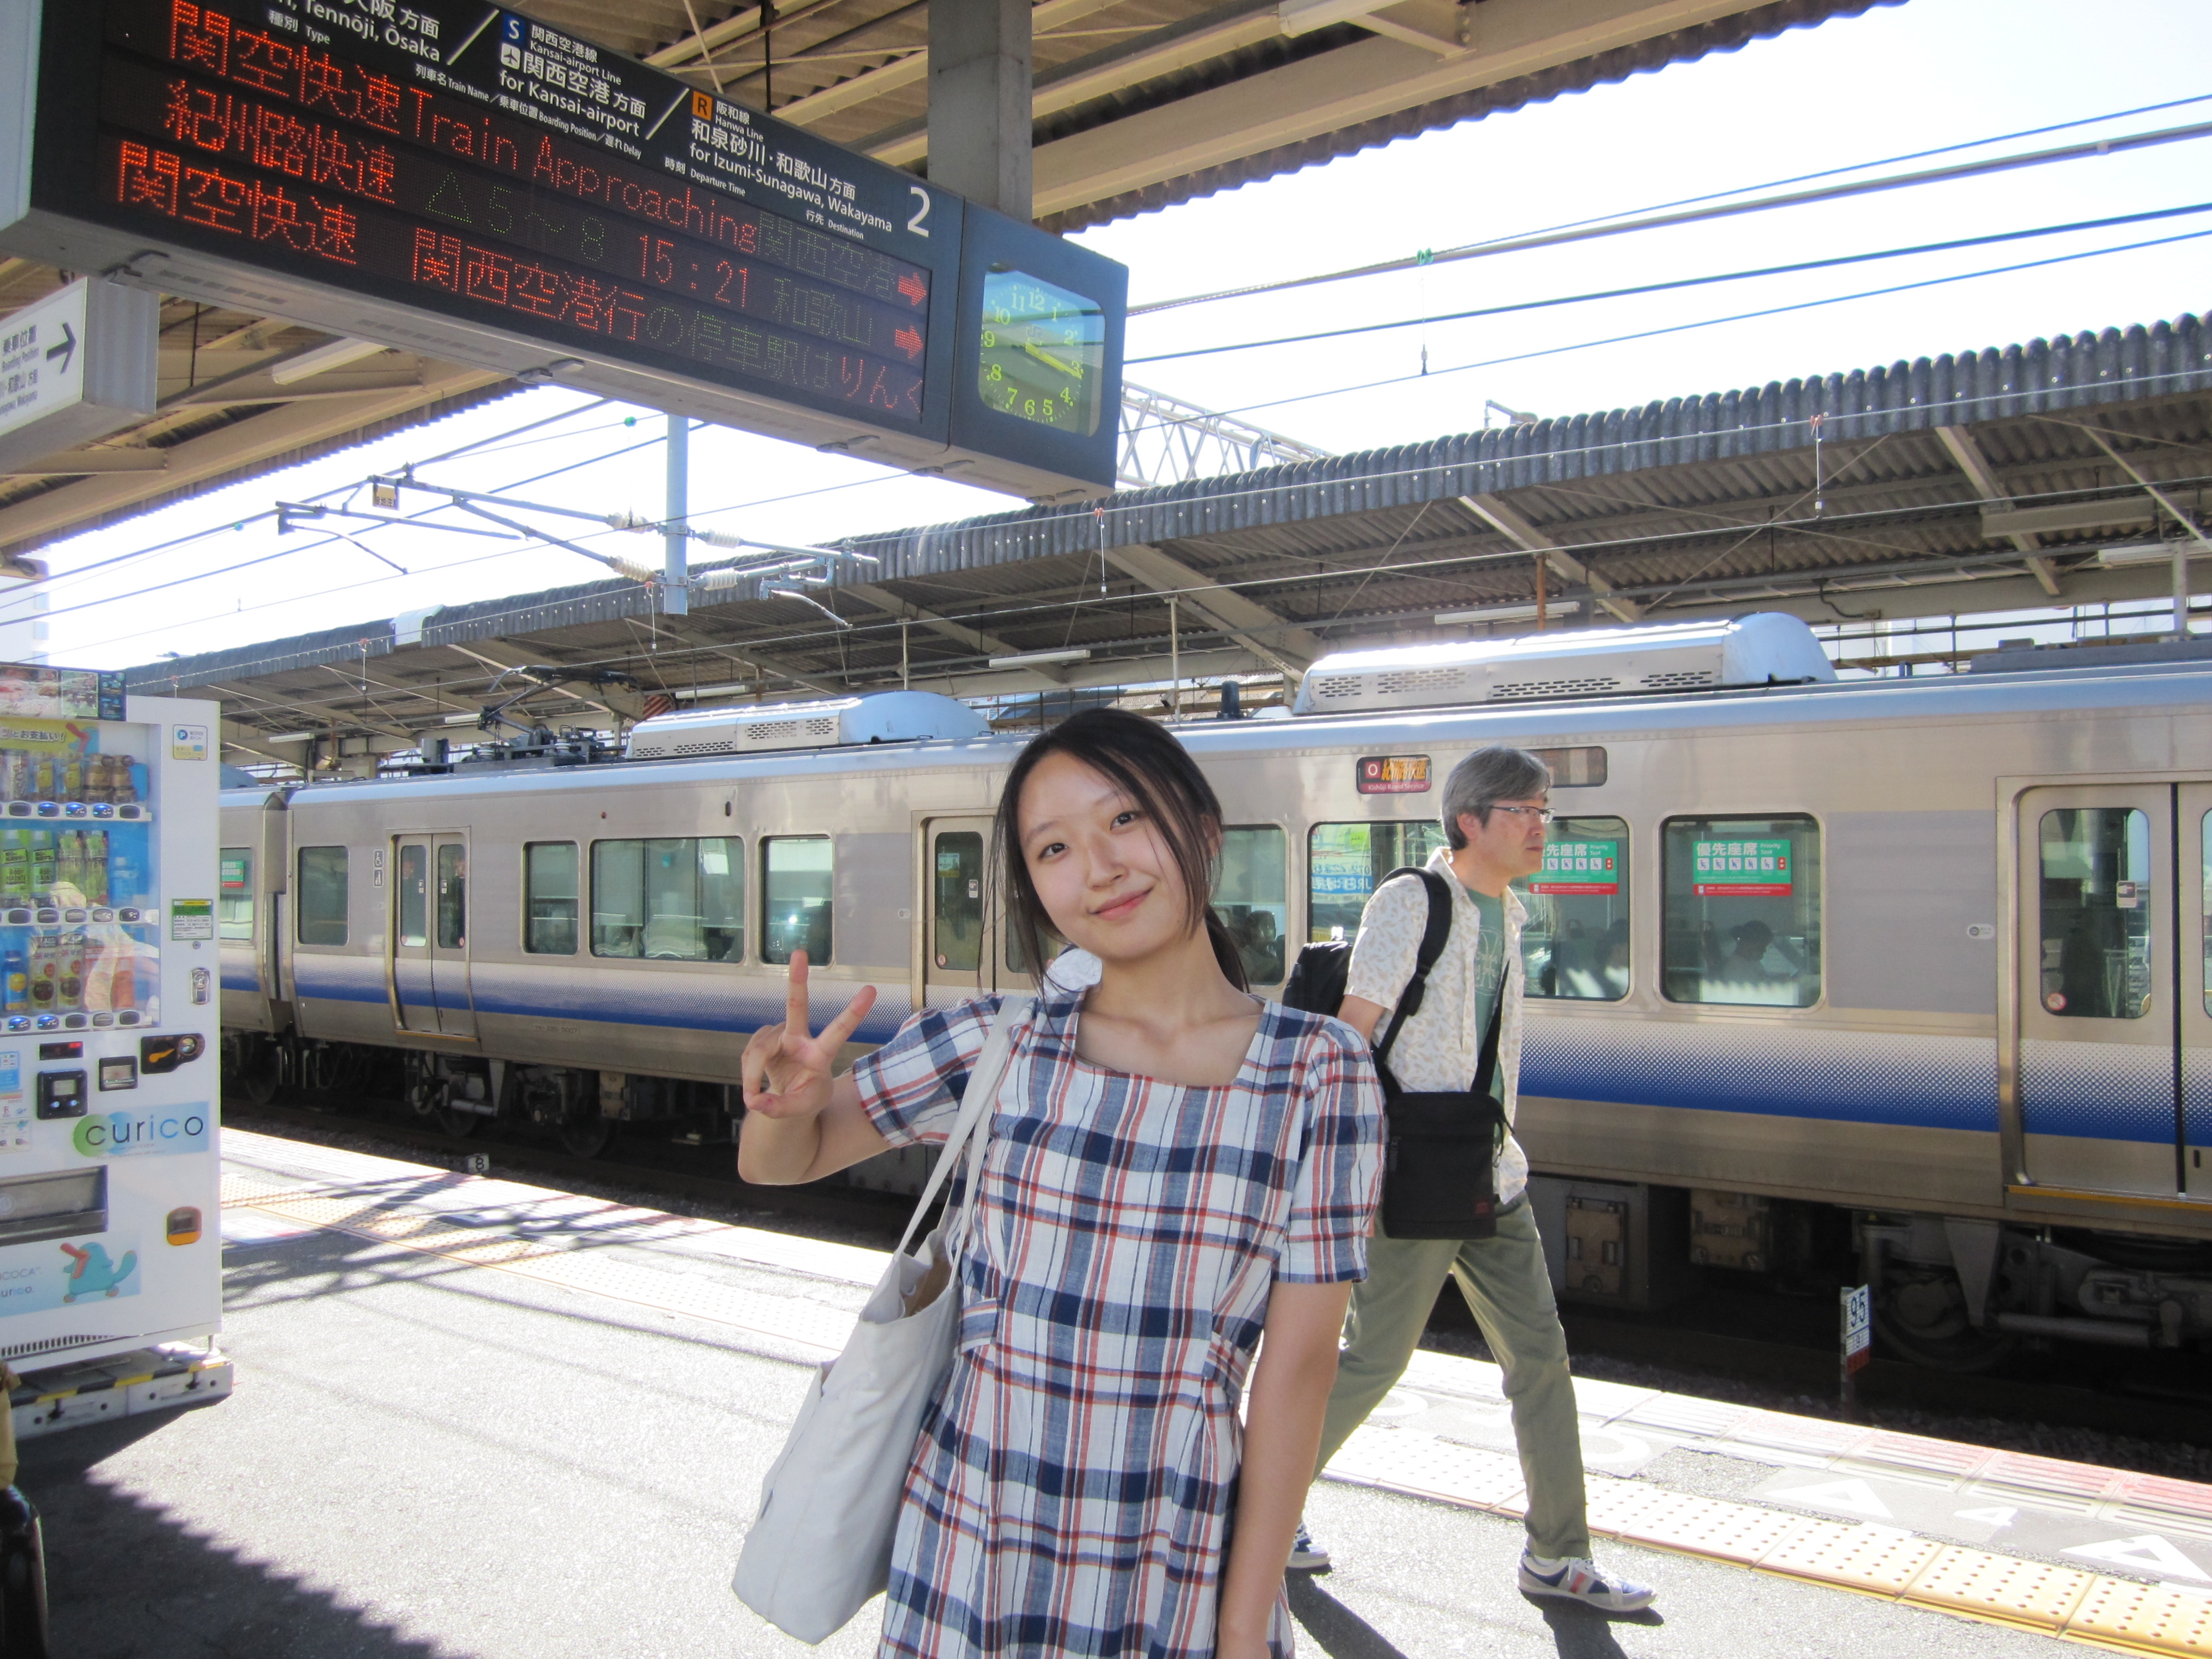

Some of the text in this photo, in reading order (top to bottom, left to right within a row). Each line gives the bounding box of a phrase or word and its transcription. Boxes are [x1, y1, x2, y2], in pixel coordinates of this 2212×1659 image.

[269, 9, 298, 32] 種別
[509, 20, 520, 39] S
[305, 25, 331, 44] Type
[385, 23, 440, 62] Ōsaka
[531, 25, 598, 63] 関西空港線
[170, 0, 400, 135] 関空快速
[530, 40, 622, 86] Kansai-airport Line
[415, 64, 447, 87] 列車名
[448, 77, 490, 102] Train Name
[499, 95, 538, 120] 乗車位置
[500, 71, 640, 137] for Kansai-airport
[697, 97, 708, 116] R
[716, 101, 749, 125] 阪和線
[539, 112, 597, 142] Boarding Position
[715, 116, 764, 143] Hanwa Line
[165, 79, 395, 204] 紀州路快速
[624, 143, 641, 160] Delay
[409, 87, 757, 255] Train Approaching
[665, 156, 686, 175] 時刻
[690, 168, 746, 197] Departure Time
[690, 142, 893, 233] for Izumi-Sunagawa, Wakayama
[117, 140, 356, 265] 関空快速
[907, 186, 931, 238] 2
[806, 210, 825, 226] 行先
[828, 219, 864, 240] Destination
[758, 211, 895, 300] 関西空港
[773, 278, 872, 346] 和歌山
[1029, 291, 1045, 311] 12
[994, 306, 1011, 325] 10
[983, 330, 995, 348] 9
[1065, 329, 1074, 346] 2
[990, 364, 1002, 381] 8
[1007, 387, 1018, 405] 7
[1060, 387, 1071, 403] 4
[1024, 399, 1035, 416] 6
[1042, 399, 1053, 416] 5
[1543, 843, 1587, 857] 先座席
[1697, 842, 1757, 856] 優先座席
[86, 1115, 204, 1146] curico
[476, 1157, 484, 1170] 8
[1850, 1291, 1865, 1328] 95
